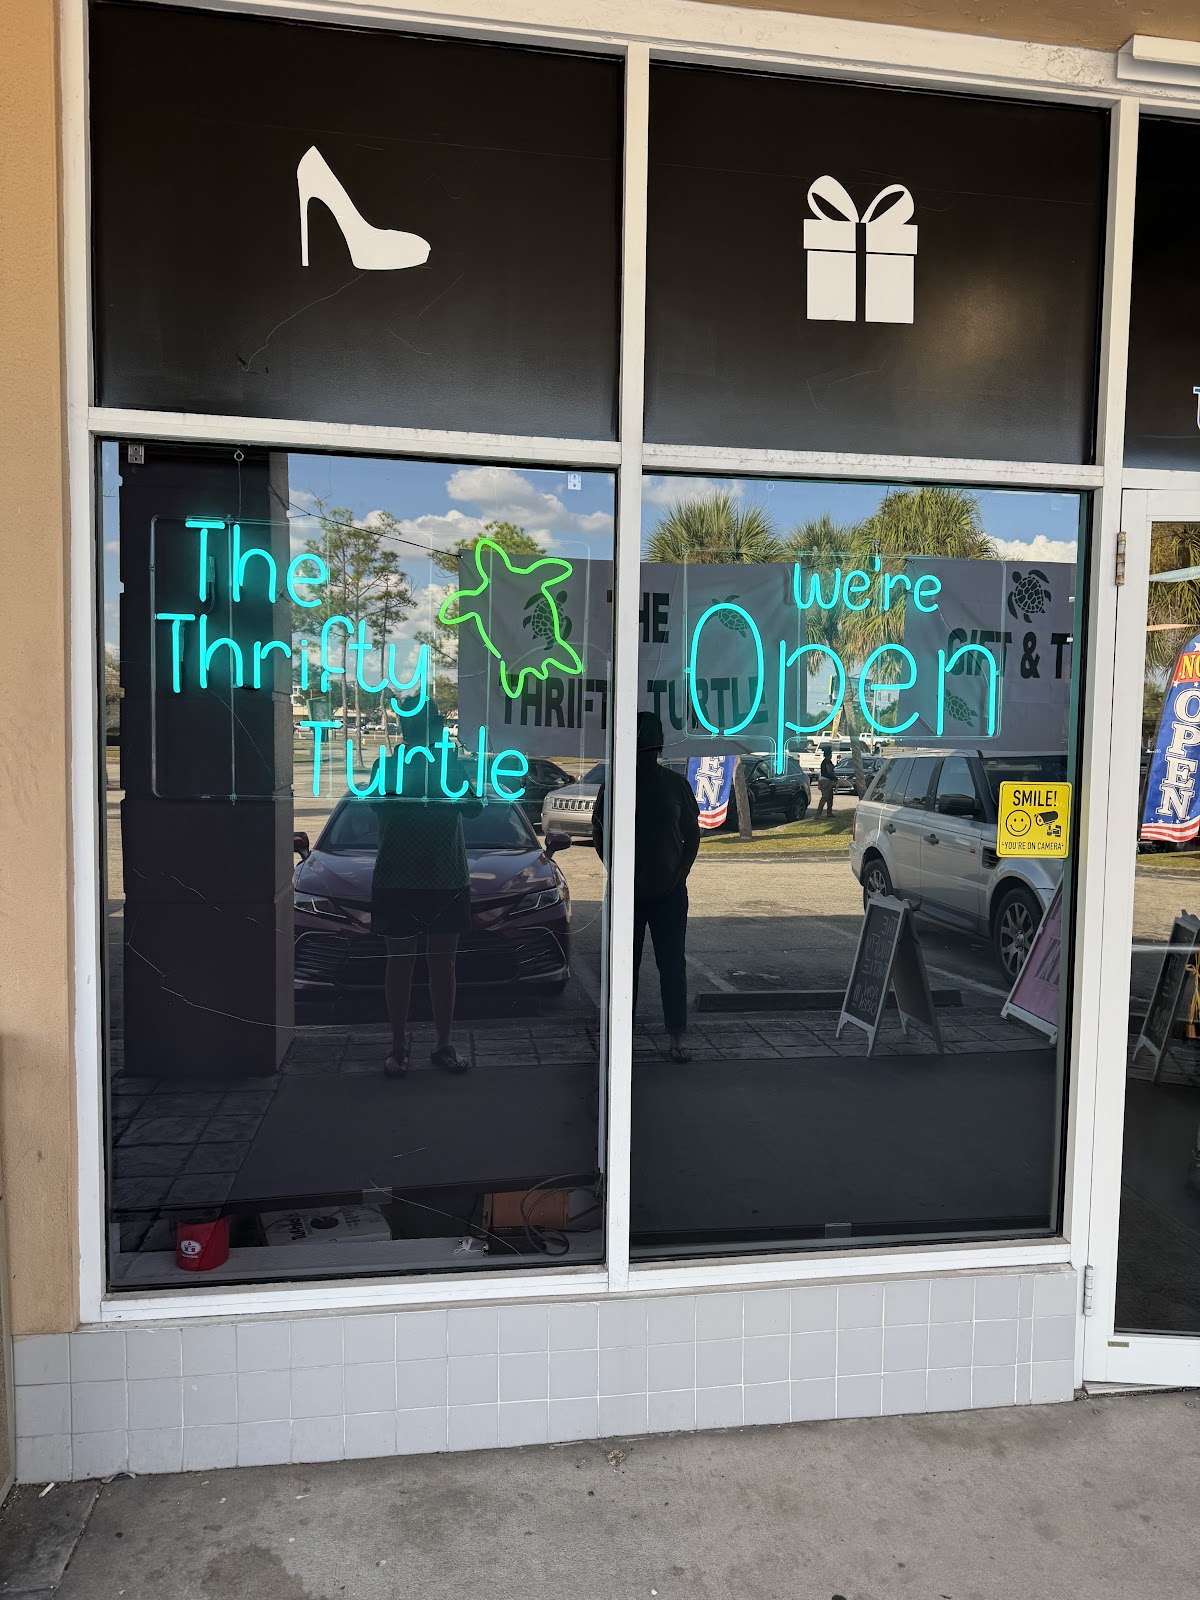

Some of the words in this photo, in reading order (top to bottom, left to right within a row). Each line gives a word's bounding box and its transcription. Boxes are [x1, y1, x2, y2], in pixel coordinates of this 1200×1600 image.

[186, 518, 328, 608] The
[793, 554, 942, 613] we're
[155, 613, 431, 717] Thrifty
[1020, 631, 1041, 679] &
[498, 672, 614, 730] THRIFT
[647, 675, 769, 730] TURTLE
[689, 602, 997, 775] Open
[300, 720, 530, 800] Turtle
[695, 756, 727, 807] EN
[1156, 688, 1200, 820] OPEN
[1012, 789, 1058, 807] SMILE!
[1027, 841, 1036, 850] ON
